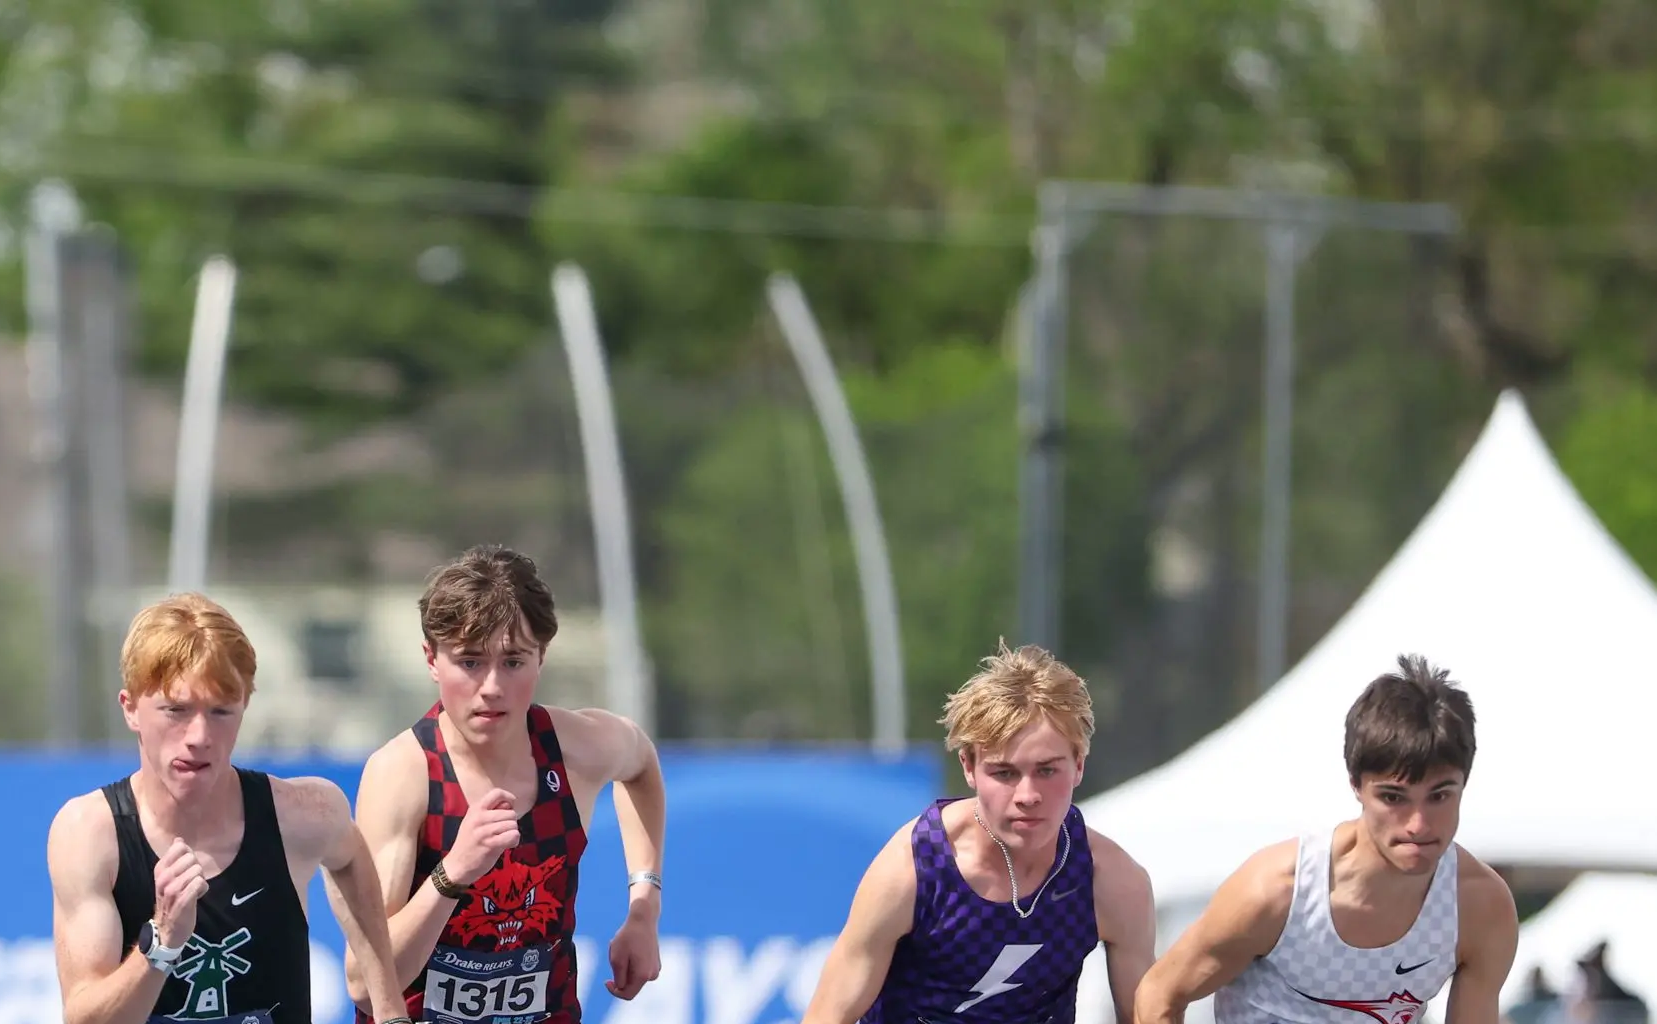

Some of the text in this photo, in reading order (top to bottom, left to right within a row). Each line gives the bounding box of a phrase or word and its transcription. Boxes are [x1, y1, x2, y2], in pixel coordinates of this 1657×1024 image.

[443, 952, 513, 972] Drake RELAYS
[437, 975, 537, 1018] 1315
